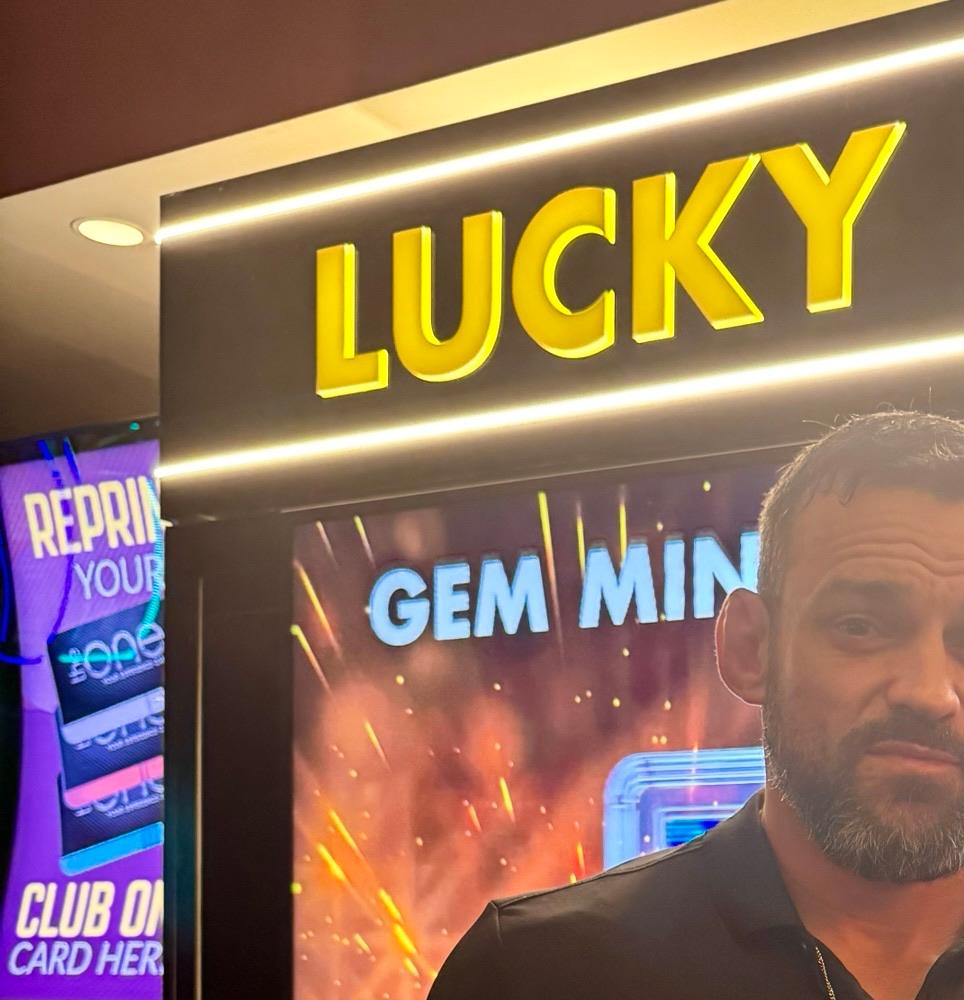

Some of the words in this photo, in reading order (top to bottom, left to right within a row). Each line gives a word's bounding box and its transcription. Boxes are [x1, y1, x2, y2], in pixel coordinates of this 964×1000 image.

[315, 121, 907, 399] LUCKY
[369, 552, 549, 647] GEM
[15, 881, 115, 938] CLUB
[8, 940, 93, 976] CARD
[95, 940, 164, 977] HER
